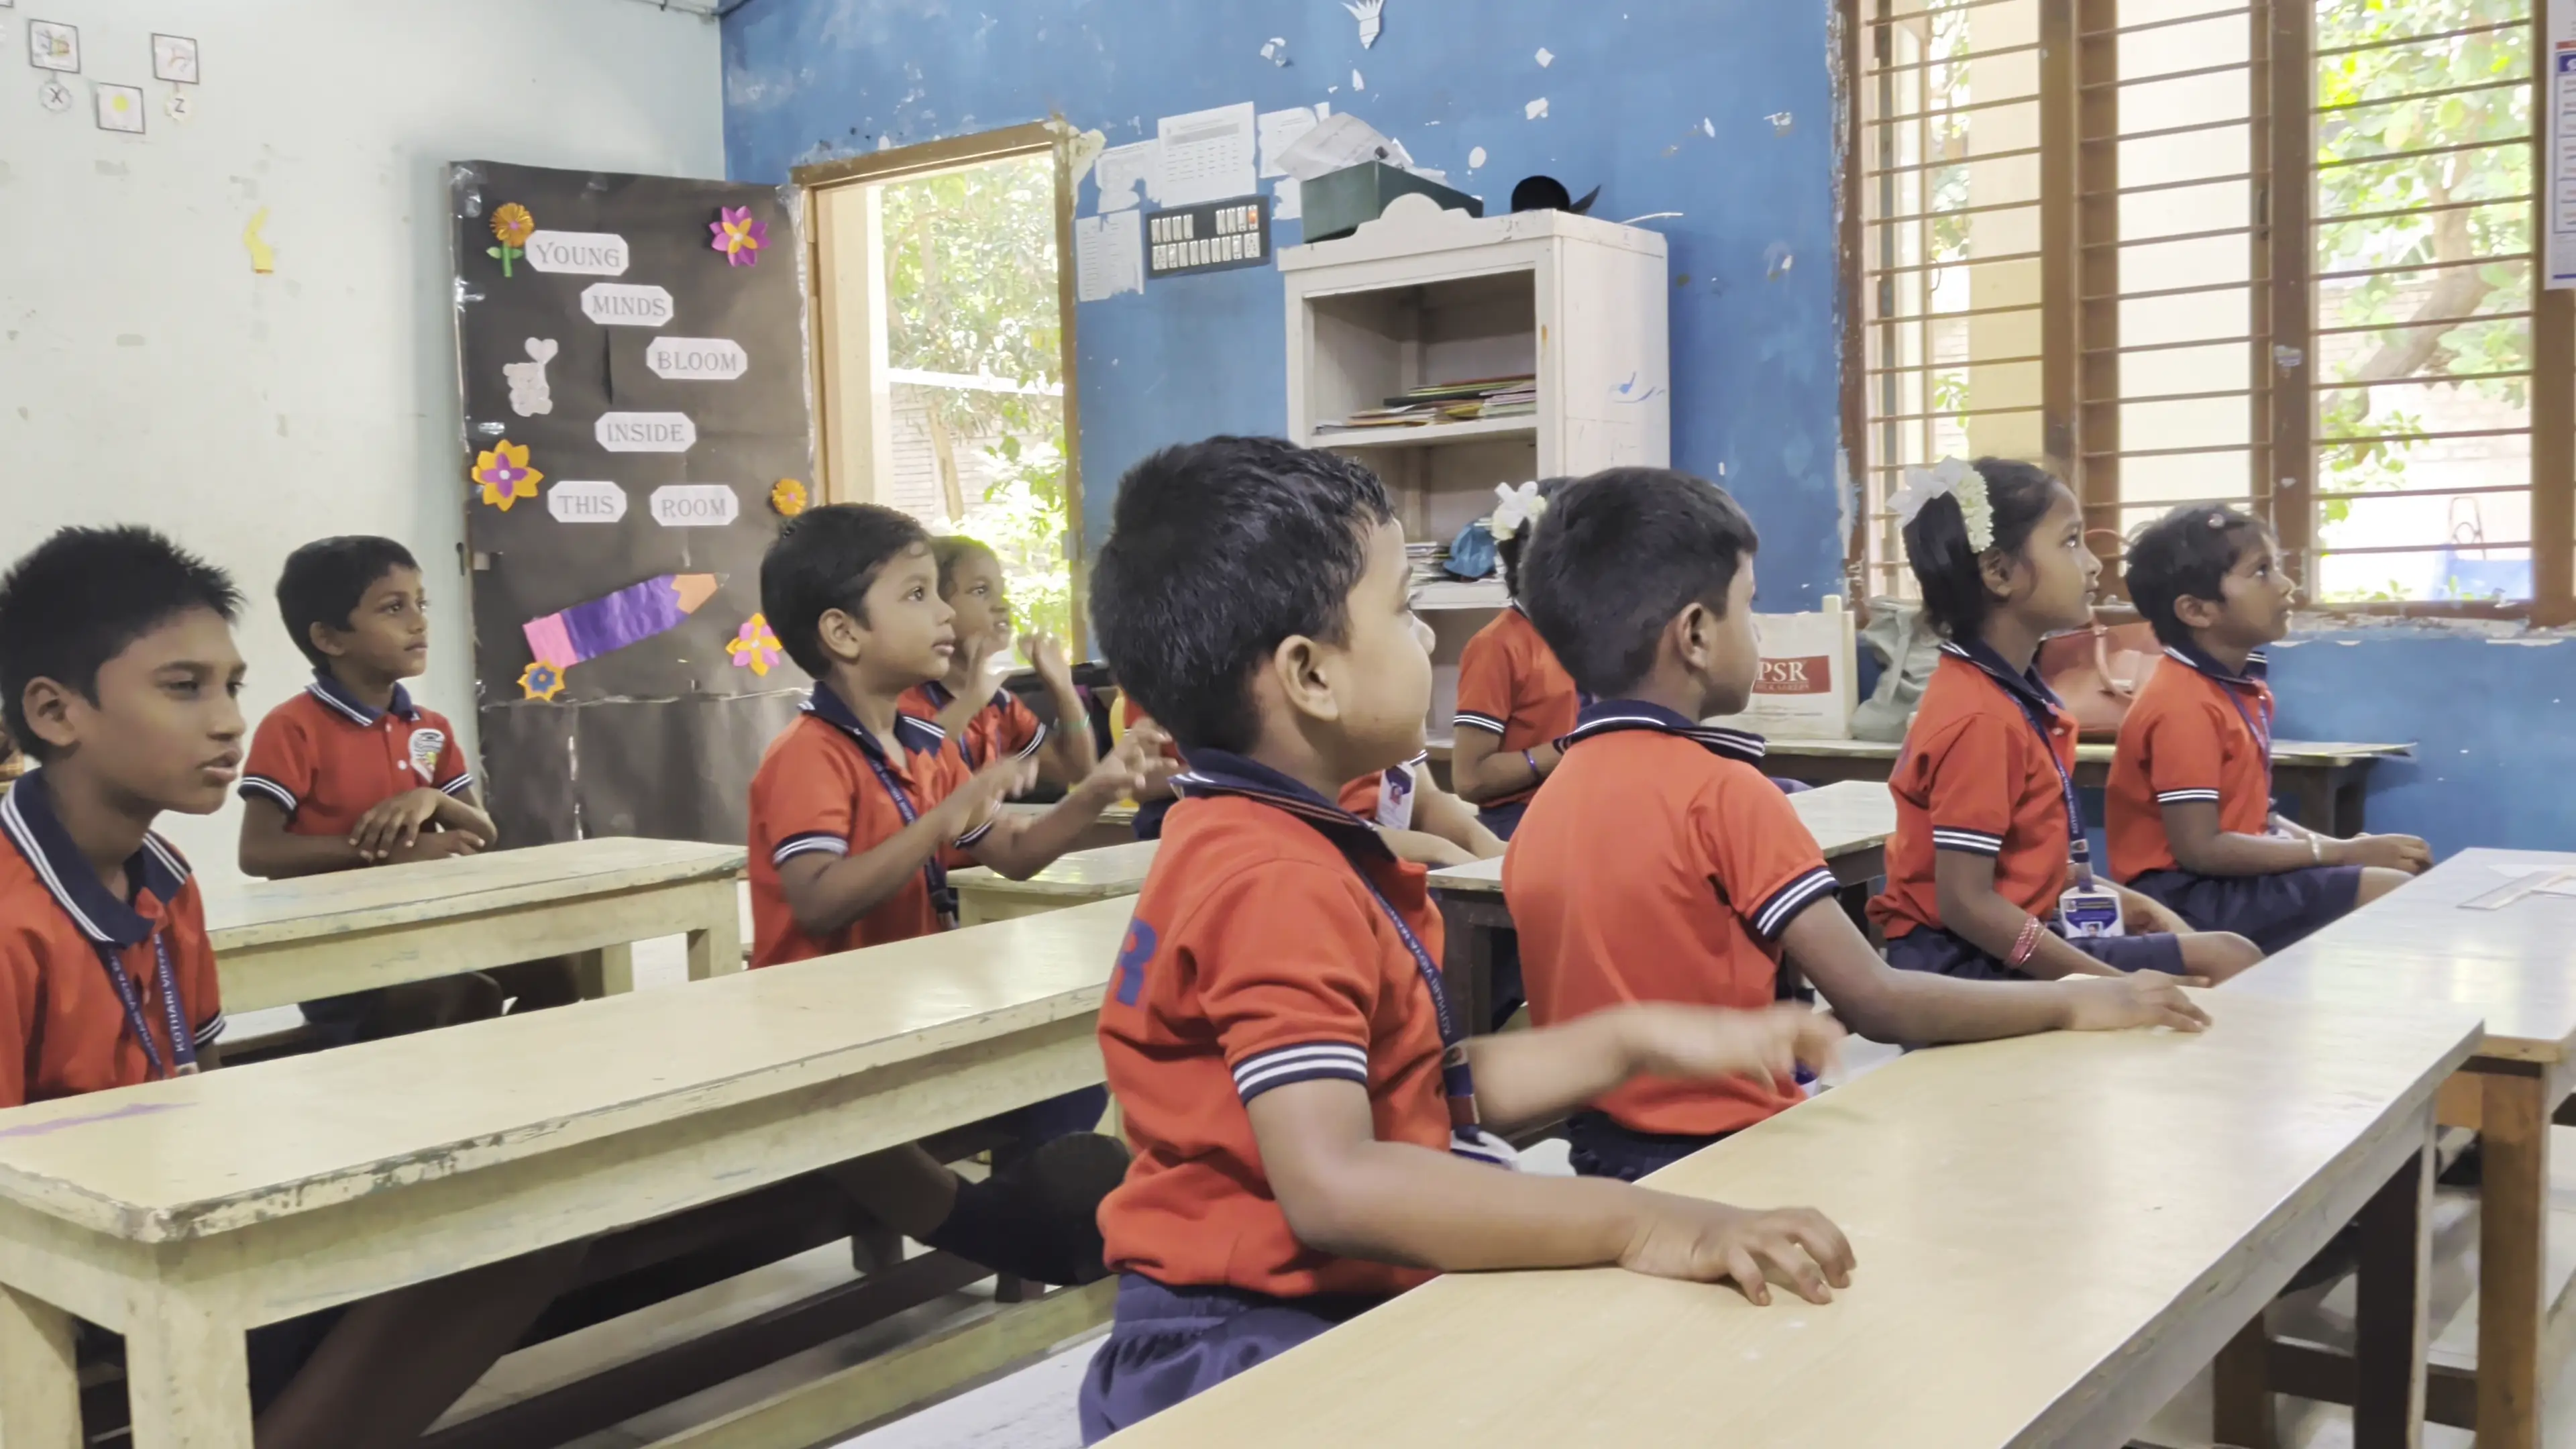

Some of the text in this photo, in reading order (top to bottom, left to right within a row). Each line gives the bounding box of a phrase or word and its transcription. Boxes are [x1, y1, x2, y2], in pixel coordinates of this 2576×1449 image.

[50, 87, 63, 104] X
[174, 98, 186, 113] Z
[536, 241, 621, 268] YOUNG
[592, 295, 667, 317] MINDS
[657, 351, 737, 372] BLOOM
[606, 423, 686, 442] INSIDE
[557, 495, 727, 518] THIS ROOM
[1756, 661, 1809, 682] PSR
[164, 989, 186, 1053] KOTHARI
